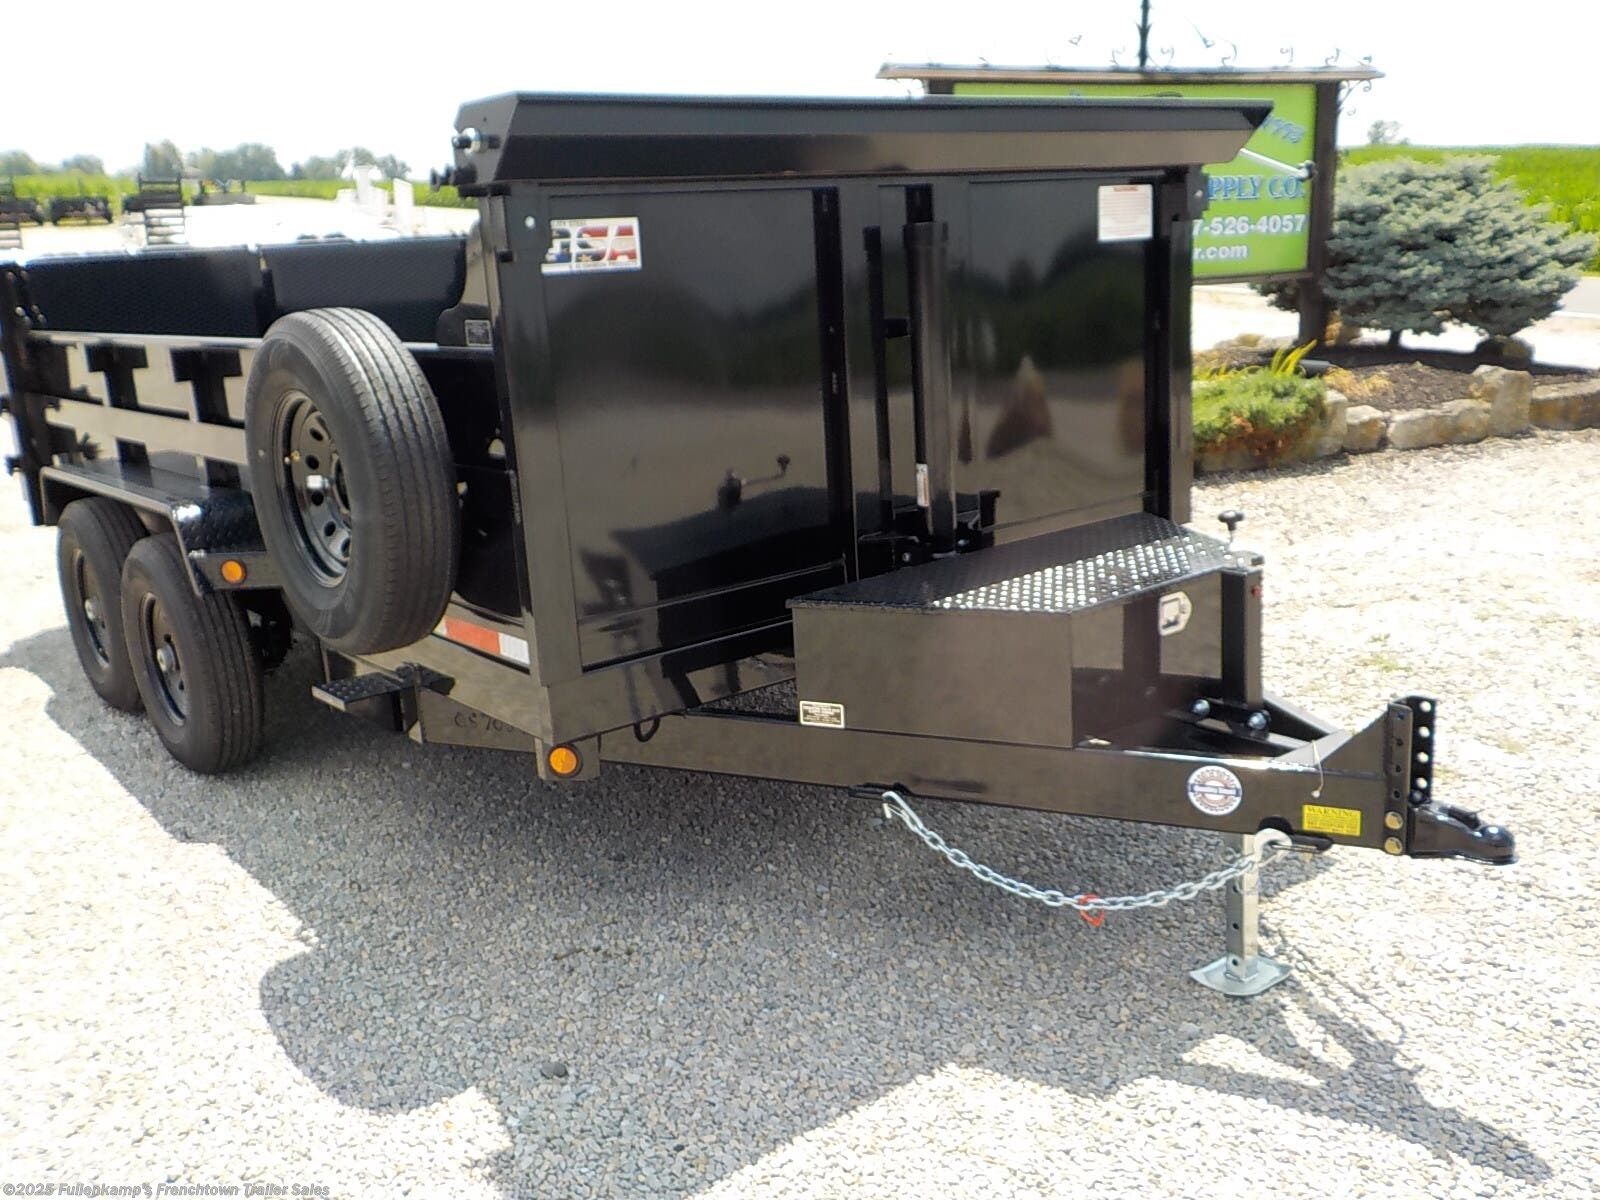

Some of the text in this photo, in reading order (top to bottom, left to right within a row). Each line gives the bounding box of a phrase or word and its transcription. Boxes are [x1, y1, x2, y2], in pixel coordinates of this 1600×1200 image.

[1207, 175, 1263, 200] PPLY
[1192, 213, 1307, 236] 7-526-4057
[1192, 246, 1248, 260] r.com
